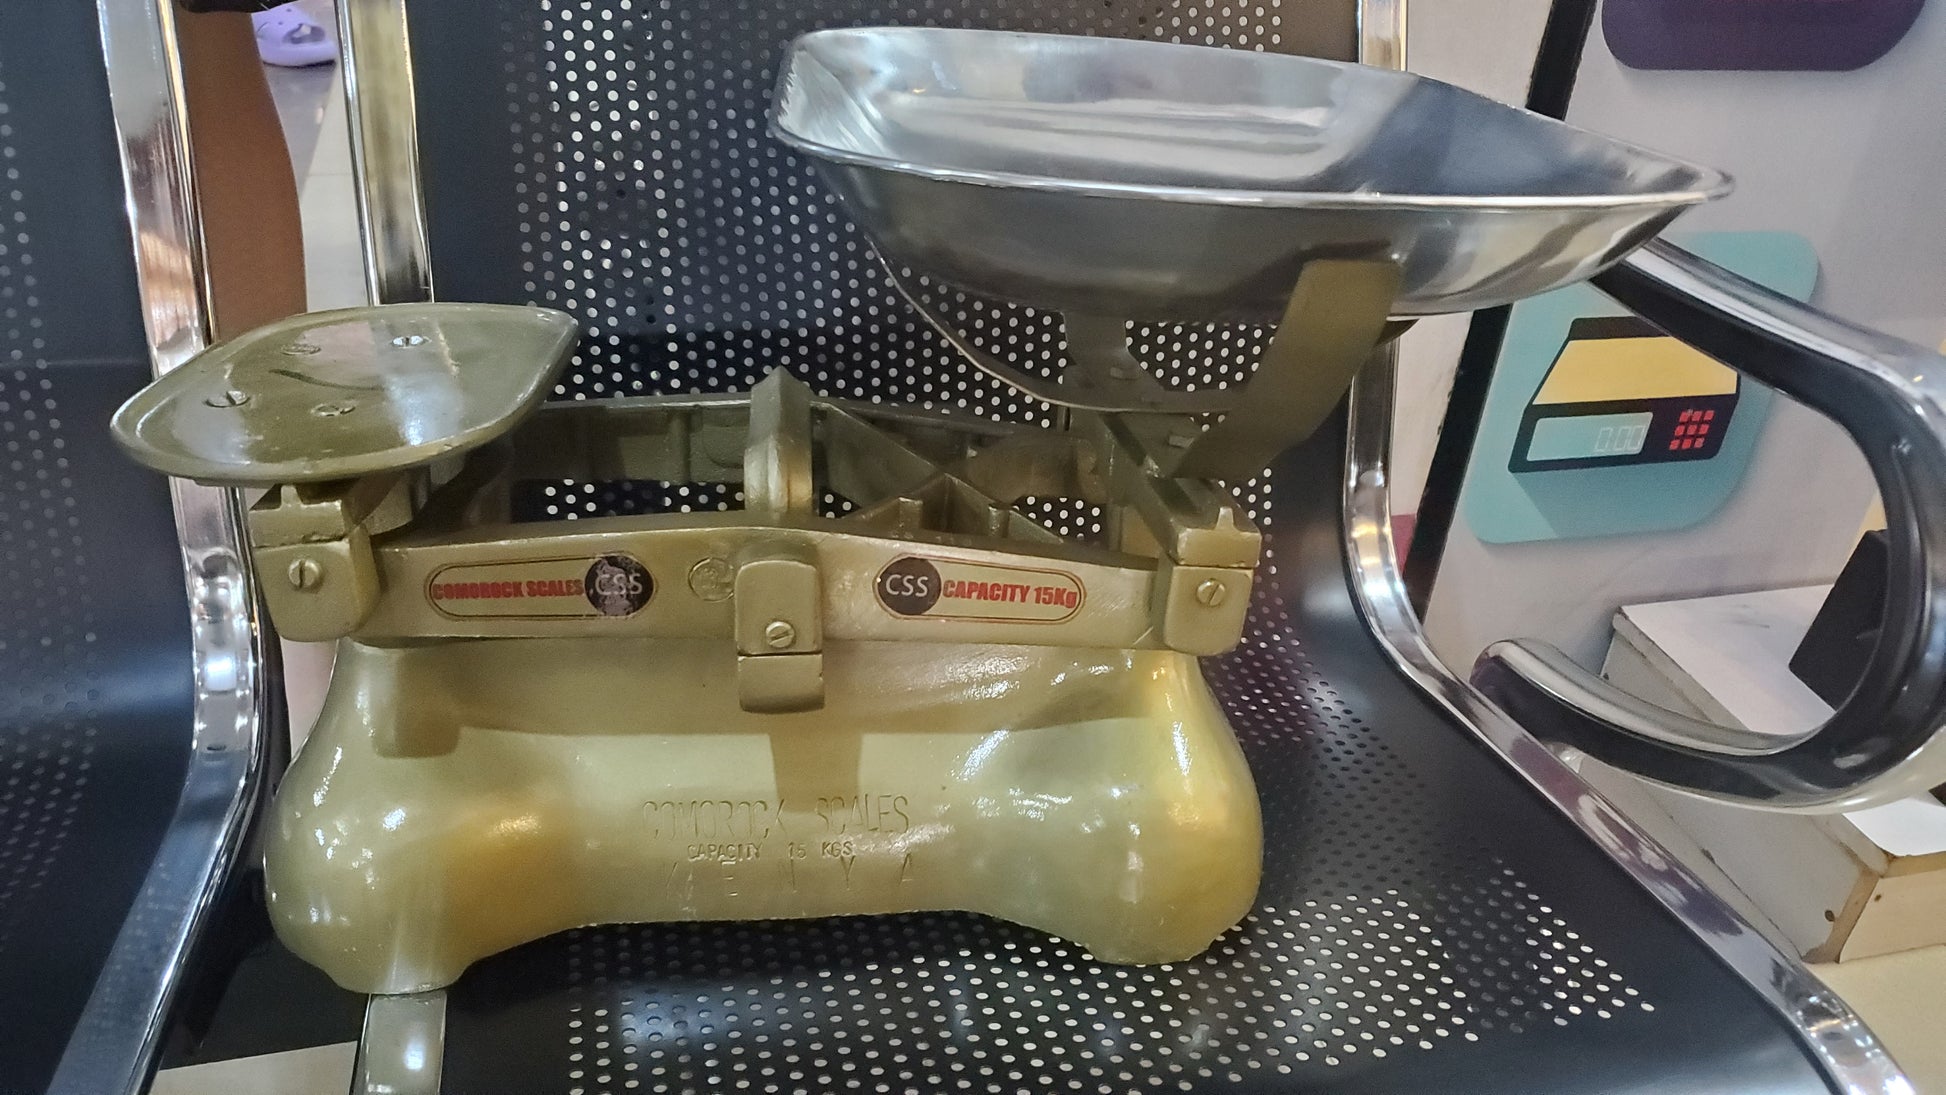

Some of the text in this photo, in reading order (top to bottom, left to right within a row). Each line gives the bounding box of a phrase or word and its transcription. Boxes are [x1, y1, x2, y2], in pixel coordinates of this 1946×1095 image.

[432, 579, 585, 600] COMOROCK SCALES
[595, 573, 643, 595] CSS
[885, 574, 929, 597] CSS
[943, 579, 1078, 608] CAPACITY 15Kg
[642, 794, 909, 840] COMOROCK SCALES
[687, 841, 854, 861] CAPACITY 15 KGS
